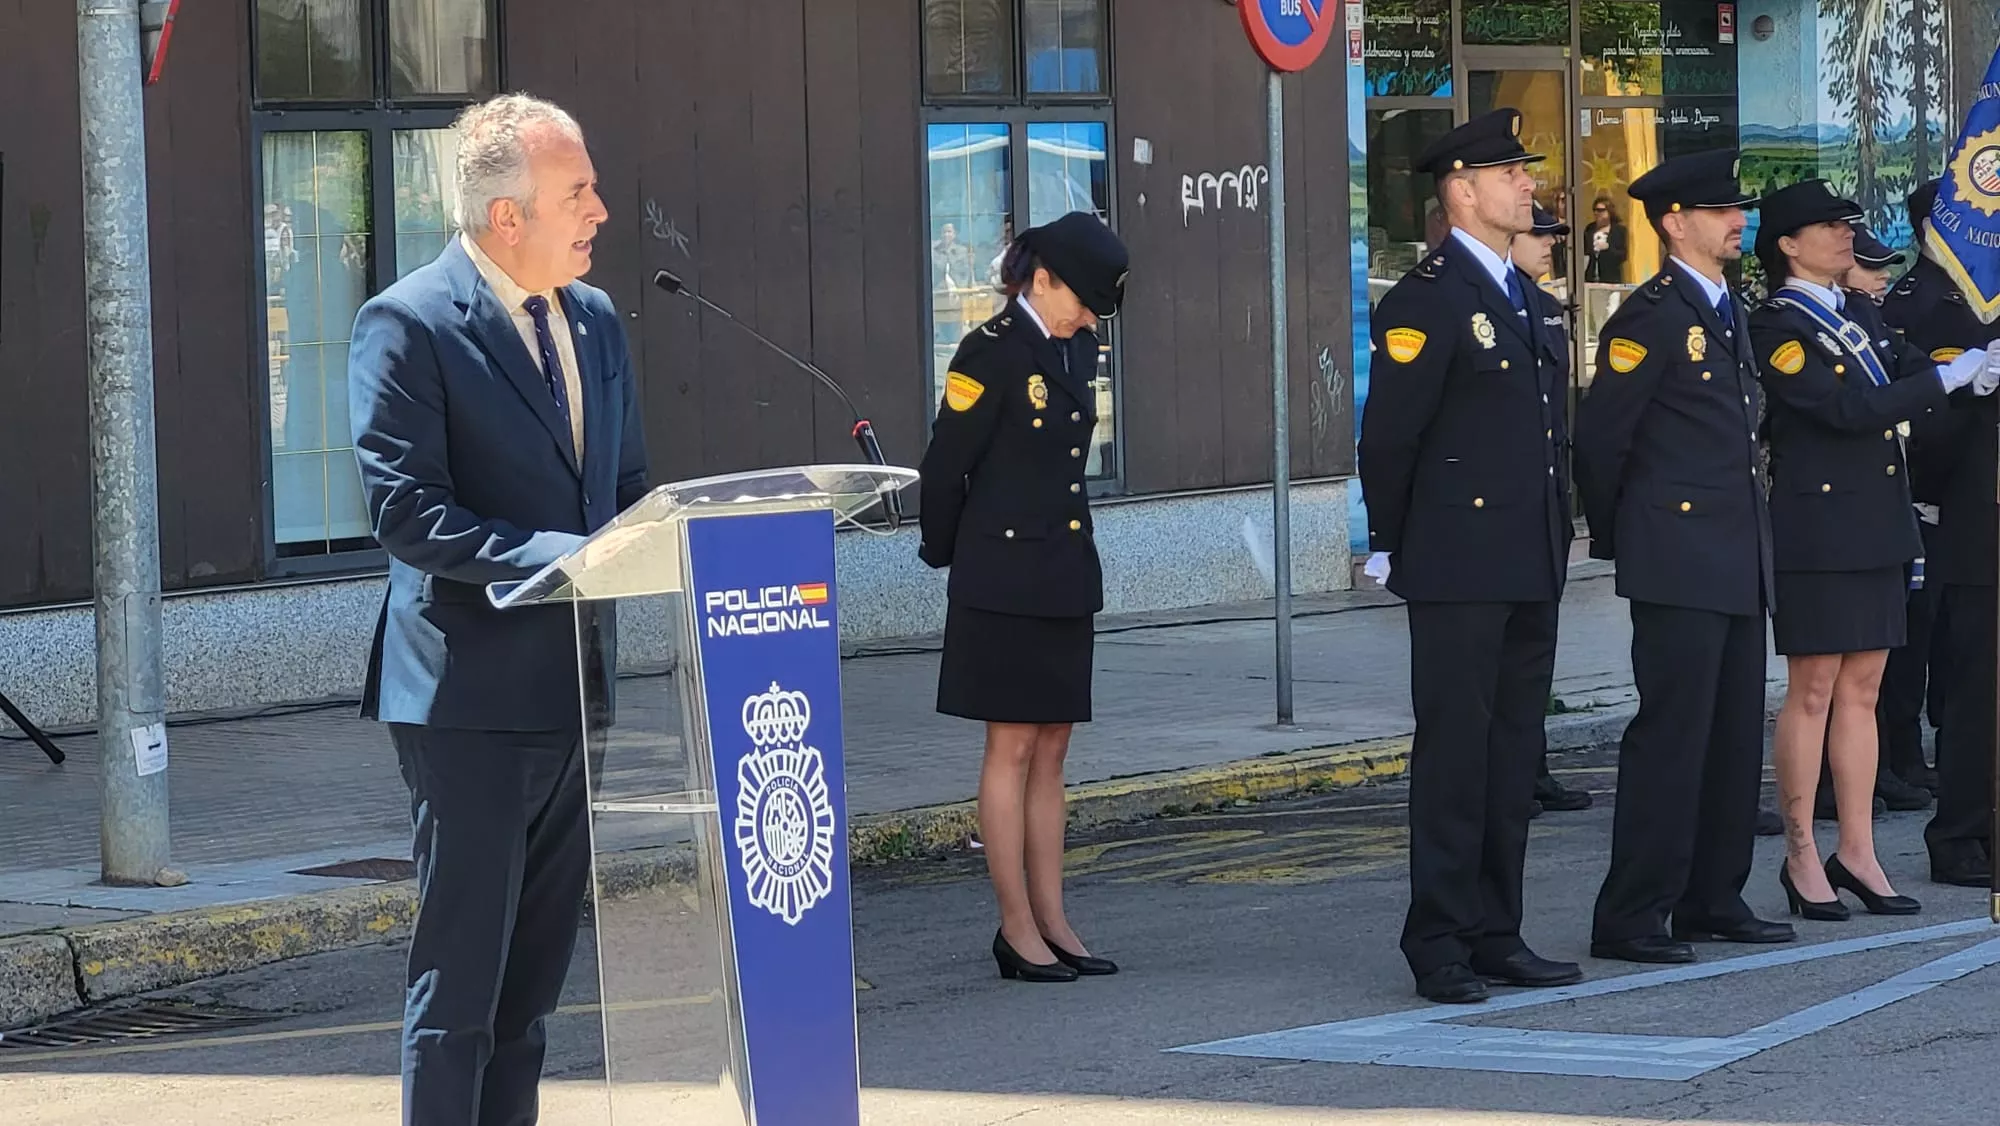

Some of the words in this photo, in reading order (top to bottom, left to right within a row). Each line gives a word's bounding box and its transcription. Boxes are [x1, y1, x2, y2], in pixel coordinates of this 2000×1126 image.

[1280, 0, 1302, 16] BUS
[705, 585, 804, 613] POLICIA
[707, 607, 830, 638] NACIONAL
[766, 852, 810, 876] NACIONAL
